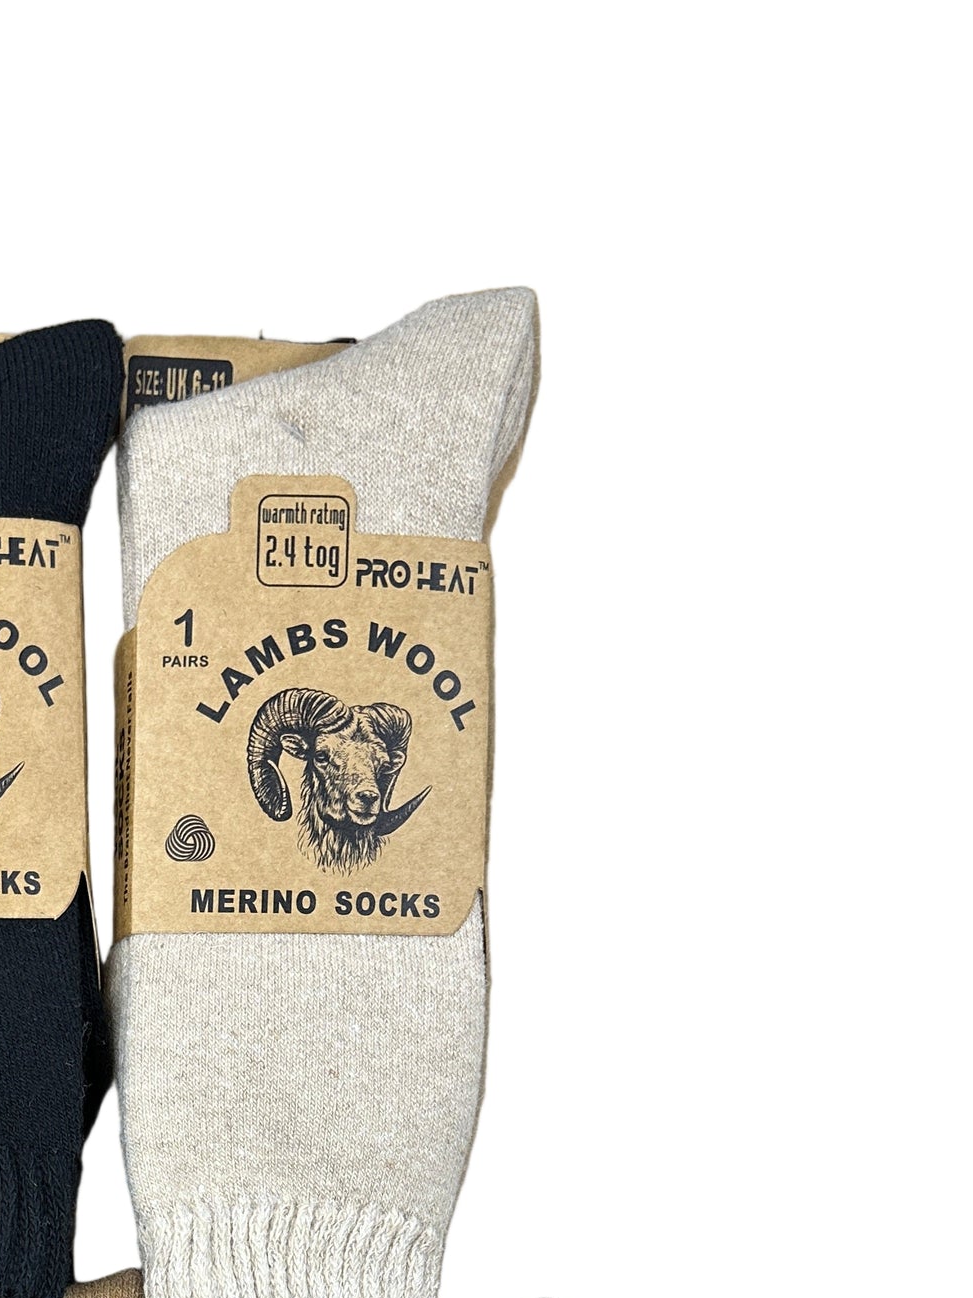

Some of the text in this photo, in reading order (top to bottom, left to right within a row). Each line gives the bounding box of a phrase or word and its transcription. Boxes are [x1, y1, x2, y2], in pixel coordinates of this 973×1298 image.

[135, 369, 163, 396] SIZE:
[167, 367, 188, 401] UK
[262, 501, 346, 532] warmth rating
[265, 535, 340, 578] 2.4 tog
[174, 608, 194, 648] 1
[162, 655, 209, 668] PAIRS
[195, 619, 476, 732] LAMBS WOOL
[190, 888, 440, 919] MERINO SOCKS
